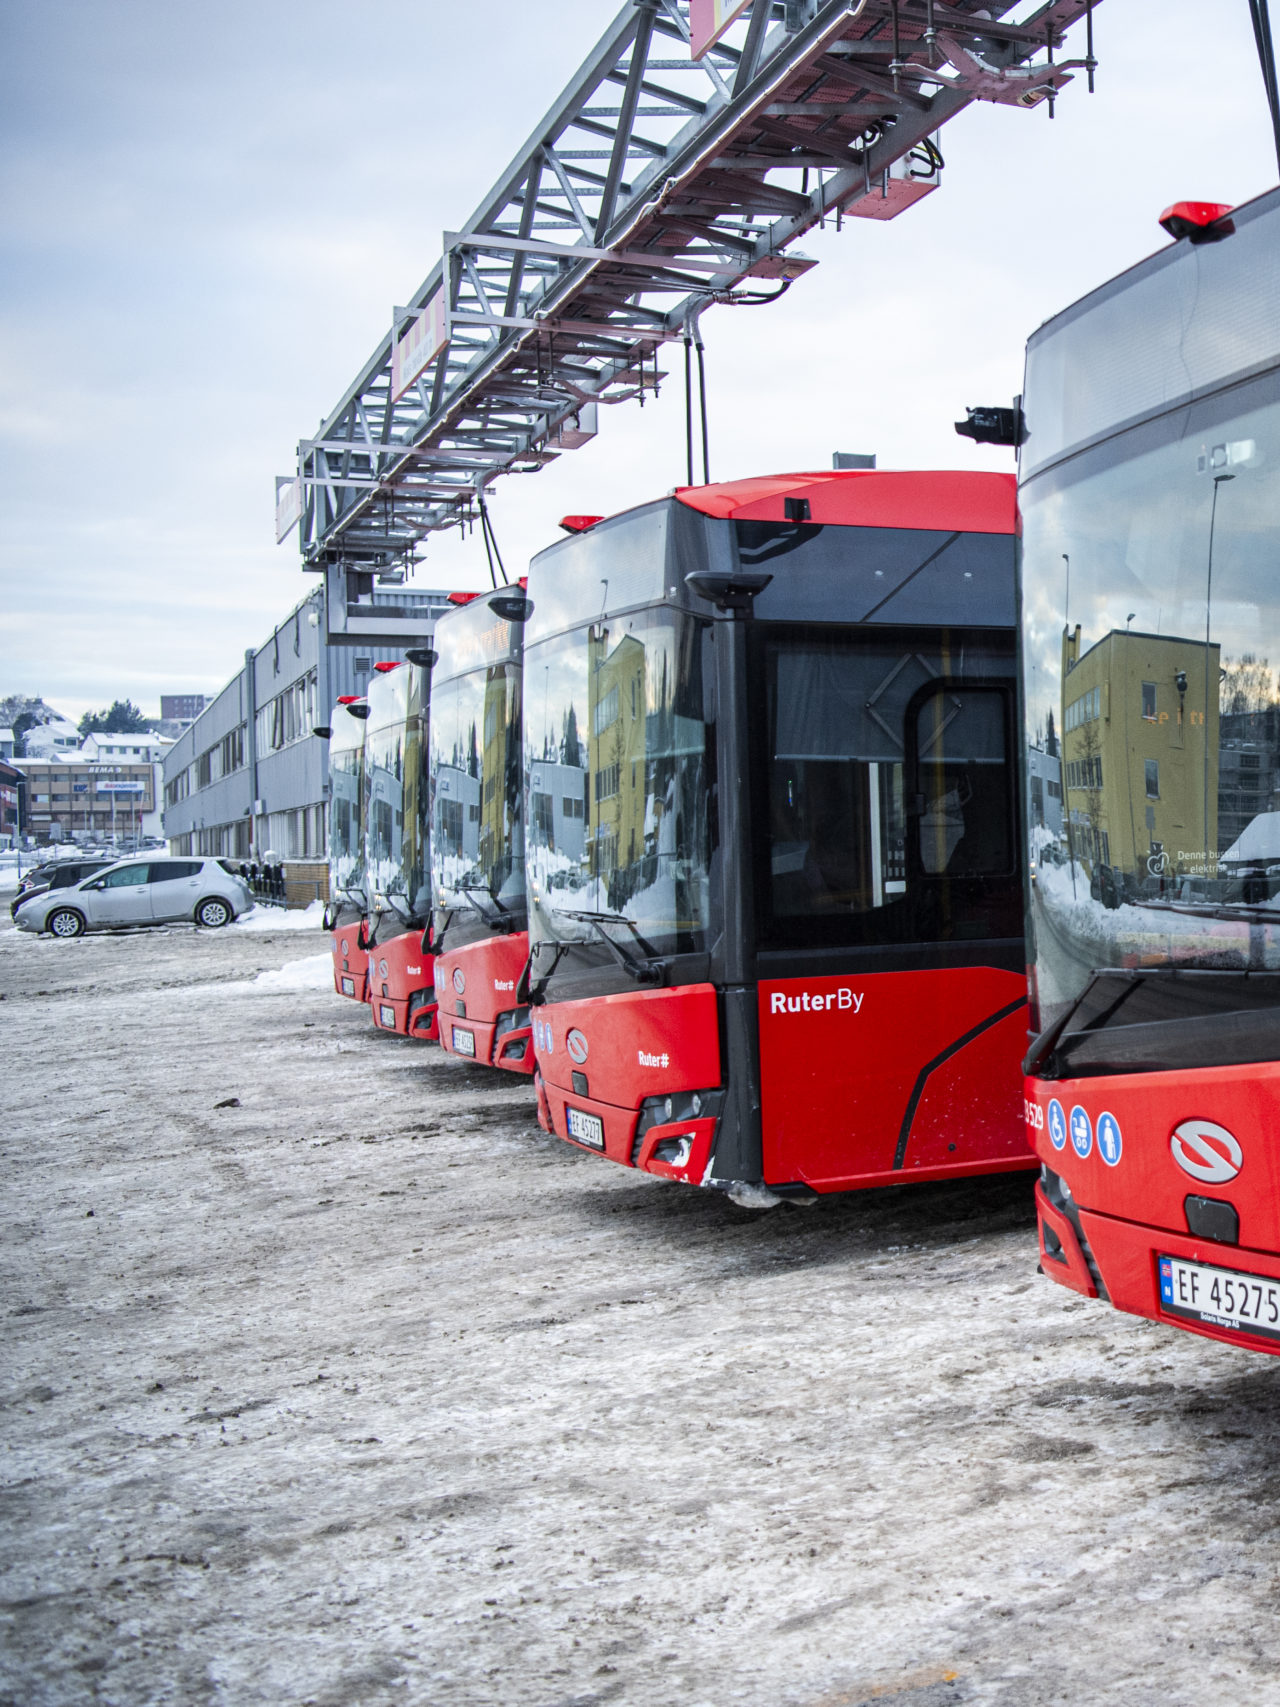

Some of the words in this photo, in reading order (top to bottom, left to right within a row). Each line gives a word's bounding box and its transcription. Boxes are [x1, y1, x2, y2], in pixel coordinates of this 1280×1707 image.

[1177, 850, 1207, 860] Denne
[1209, 850, 1240, 859] bussen
[494, 978, 514, 991] Ruter#
[770, 988, 865, 1014] RuterBy
[638, 1050, 670, 1068] Ruter#
[572, 1113, 579, 1134] EF
[581, 1117, 600, 1142] 45277
[1178, 1268, 1199, 1304] EF
[1210, 1277, 1279, 1323] 45275
[1200, 1311, 1217, 1323] Solaris
[1232, 1320, 1240, 1329] AS
